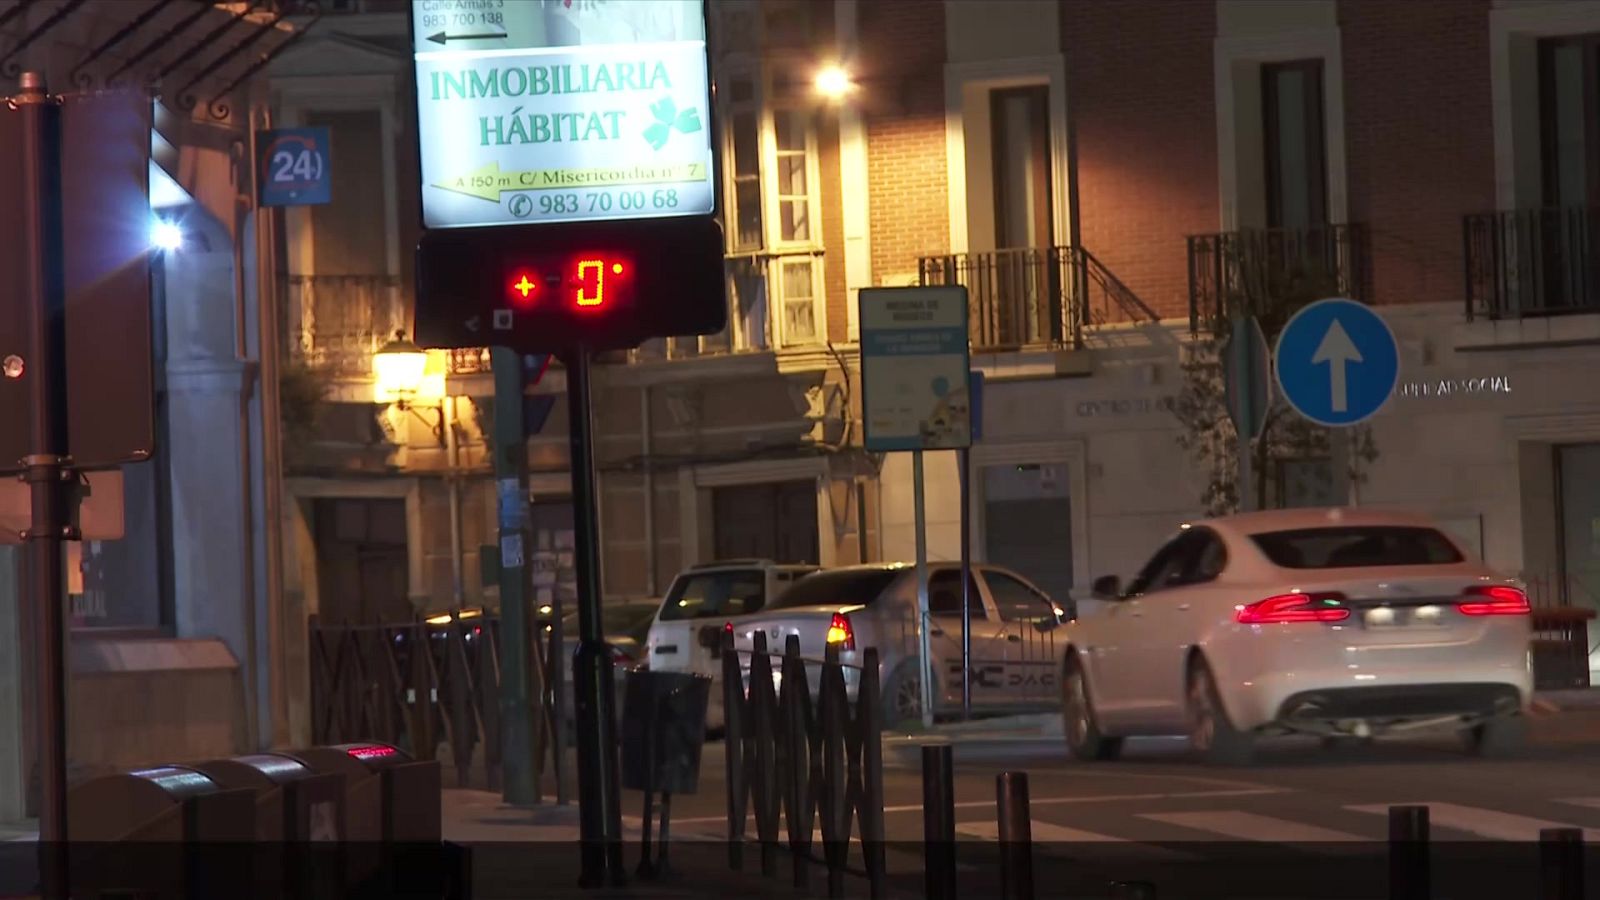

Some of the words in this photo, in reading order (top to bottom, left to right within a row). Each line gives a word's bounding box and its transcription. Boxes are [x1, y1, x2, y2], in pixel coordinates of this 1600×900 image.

[422, 14, 447, 27] 983
[452, 13, 475, 25] 700
[479, 12, 504, 24] 138
[429, 60, 672, 101] INMOBILIARIA
[479, 106, 626, 146] HÁBITAT
[455, 177, 465, 188] A
[471, 175, 493, 188] 150
[497, 177, 511, 187] m
[518, 172, 538, 187] C/
[542, 166, 656, 185] Misericordia
[687, 163, 698, 177] 7
[539, 194, 579, 214] 983
[586, 192, 612, 212] 70
[620, 191, 645, 210] 00
[652, 189, 679, 209] 68
[1462, 375, 1512, 391] SOCIAL
